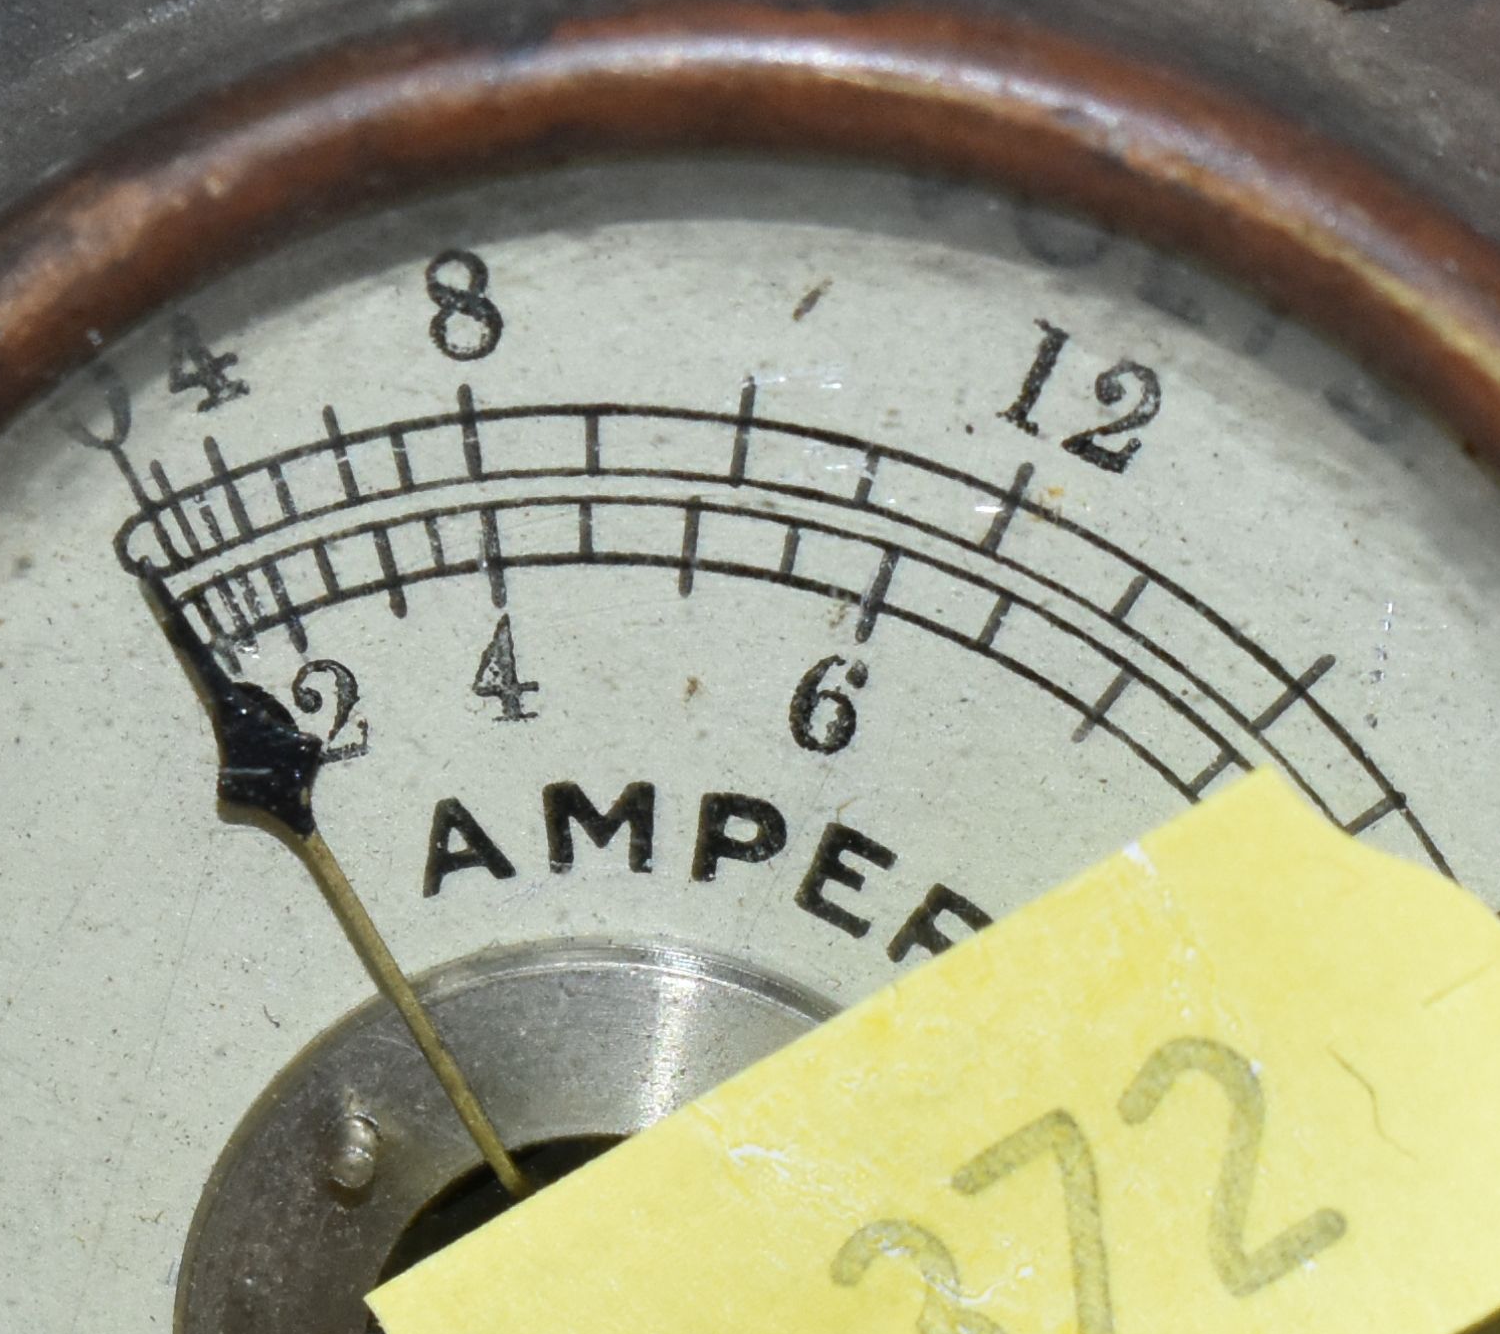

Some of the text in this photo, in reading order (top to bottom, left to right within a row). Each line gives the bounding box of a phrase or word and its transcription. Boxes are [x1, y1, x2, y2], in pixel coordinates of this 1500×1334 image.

[168, 310, 250, 412] 4
[424, 248, 504, 362] 8
[996, 317, 1162, 474] 12
[292, 613, 867, 764] 2 4 6
